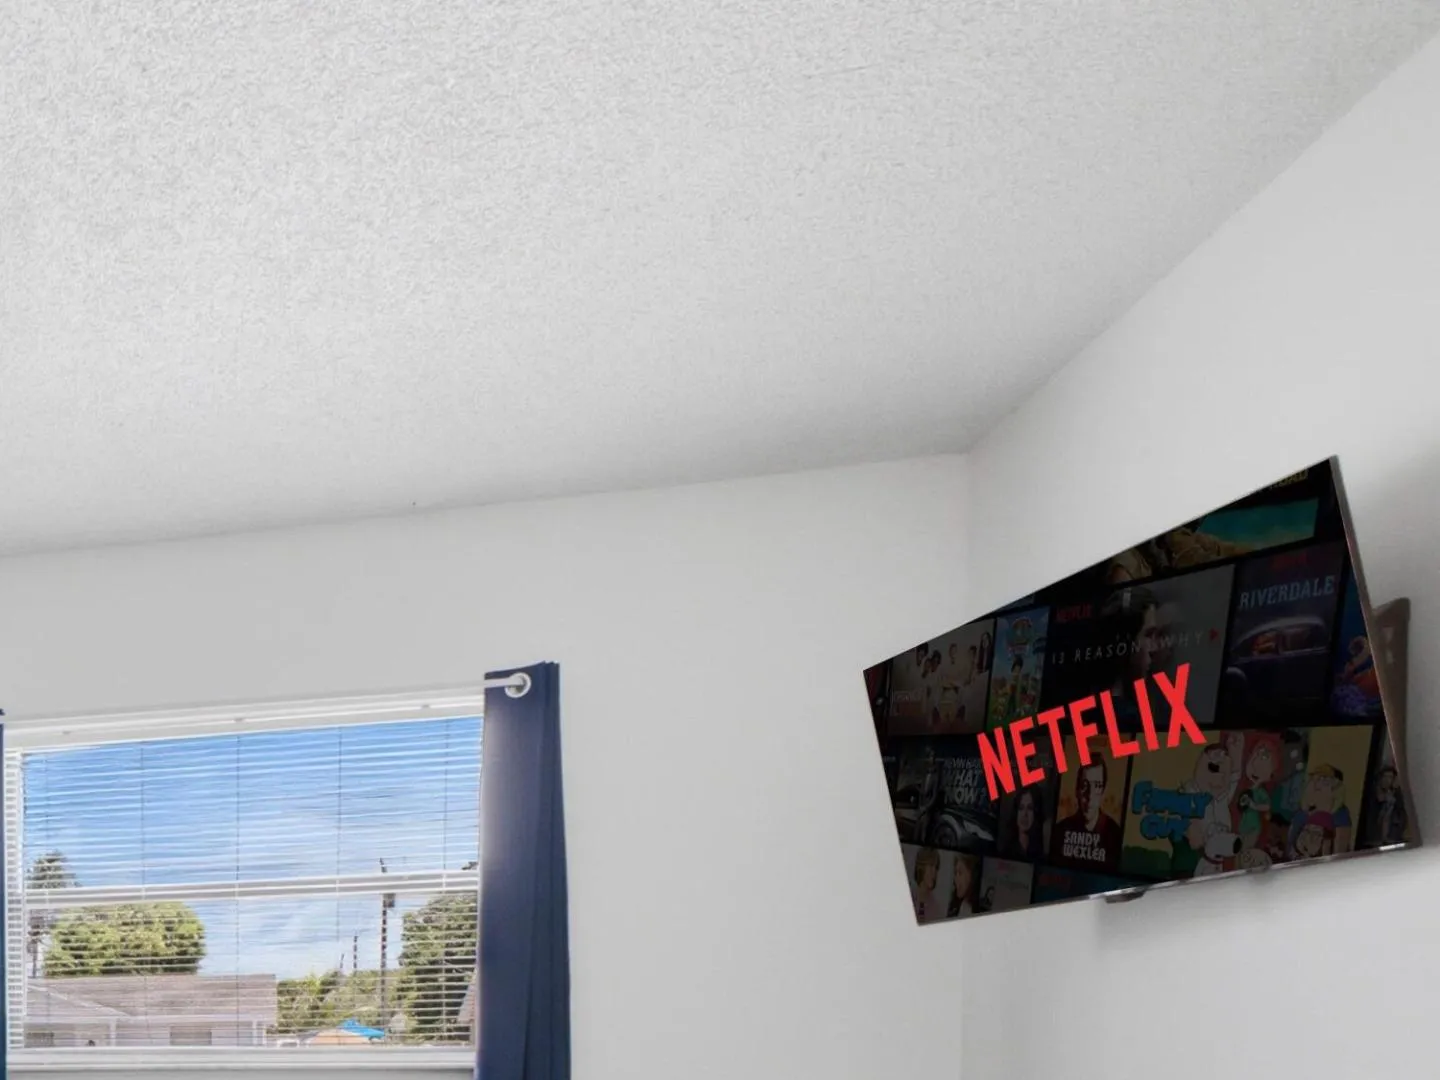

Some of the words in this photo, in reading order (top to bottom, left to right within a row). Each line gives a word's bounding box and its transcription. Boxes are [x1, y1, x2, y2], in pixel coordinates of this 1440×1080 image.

[1238, 575, 1336, 609] RIVERDALE
[1051, 651, 1066, 666] 13
[1160, 630, 1204, 649] WHY
[976, 663, 1207, 801] NETFLIX
[1063, 830, 1101, 848] SANDY
[1063, 843, 1107, 863] WEXLER
